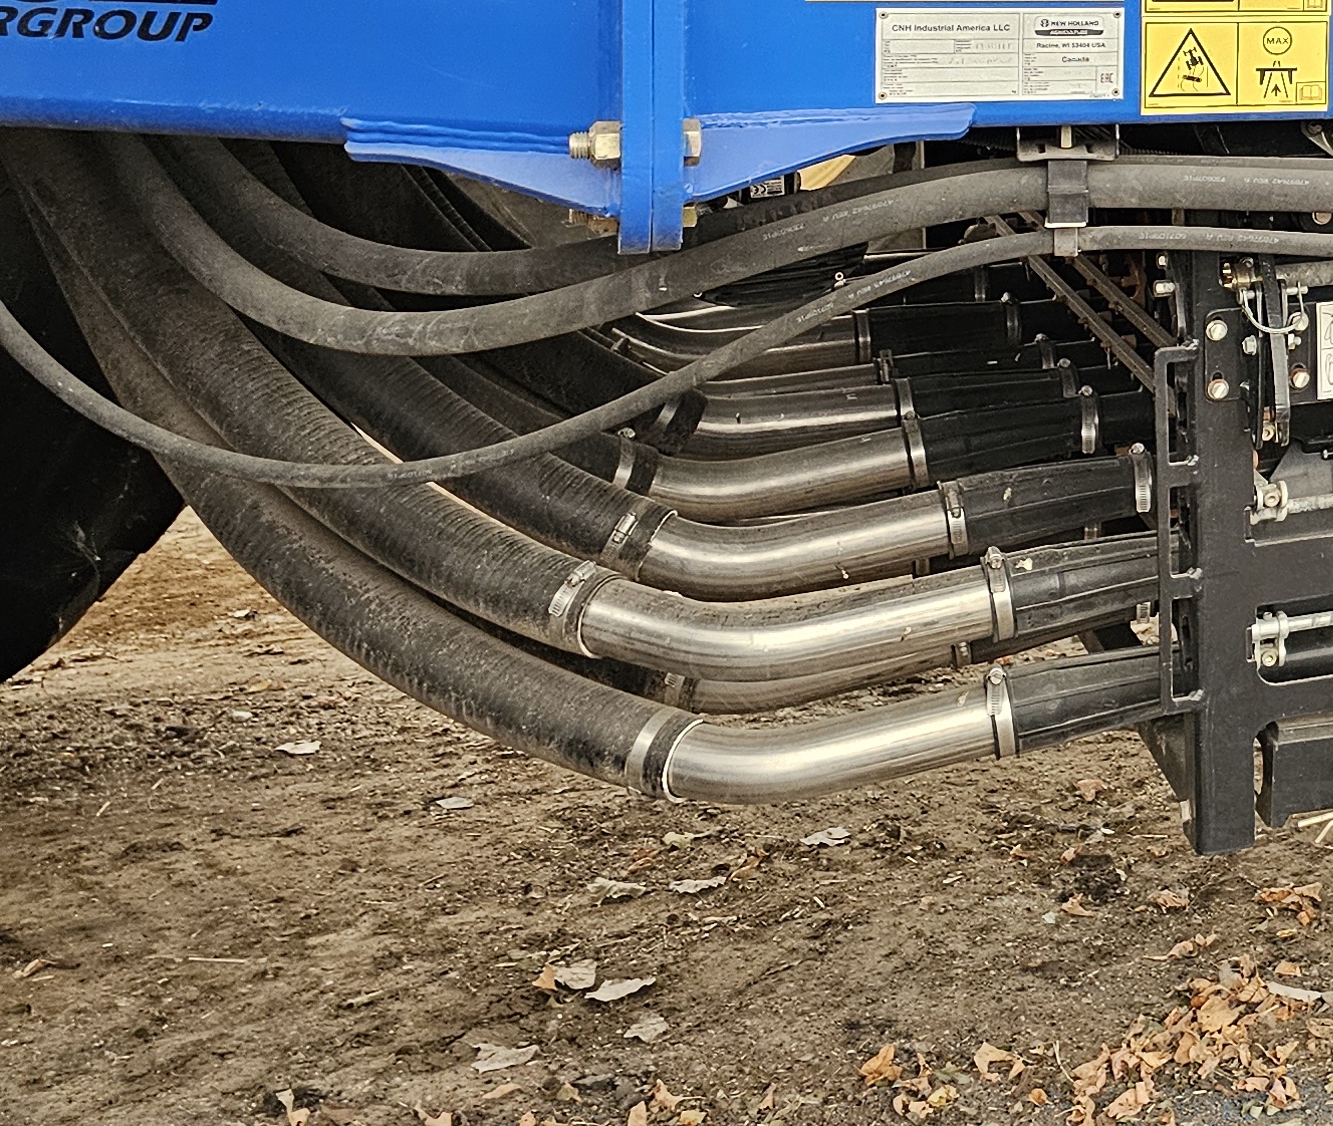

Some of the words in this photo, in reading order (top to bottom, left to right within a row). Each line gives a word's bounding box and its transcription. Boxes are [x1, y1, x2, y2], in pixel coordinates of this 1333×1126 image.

[892, 24, 912, 32] CNH
[914, 24, 954, 32] Industrial
[957, 24, 991, 32] America
[1266, 37, 1289, 45] MAX
